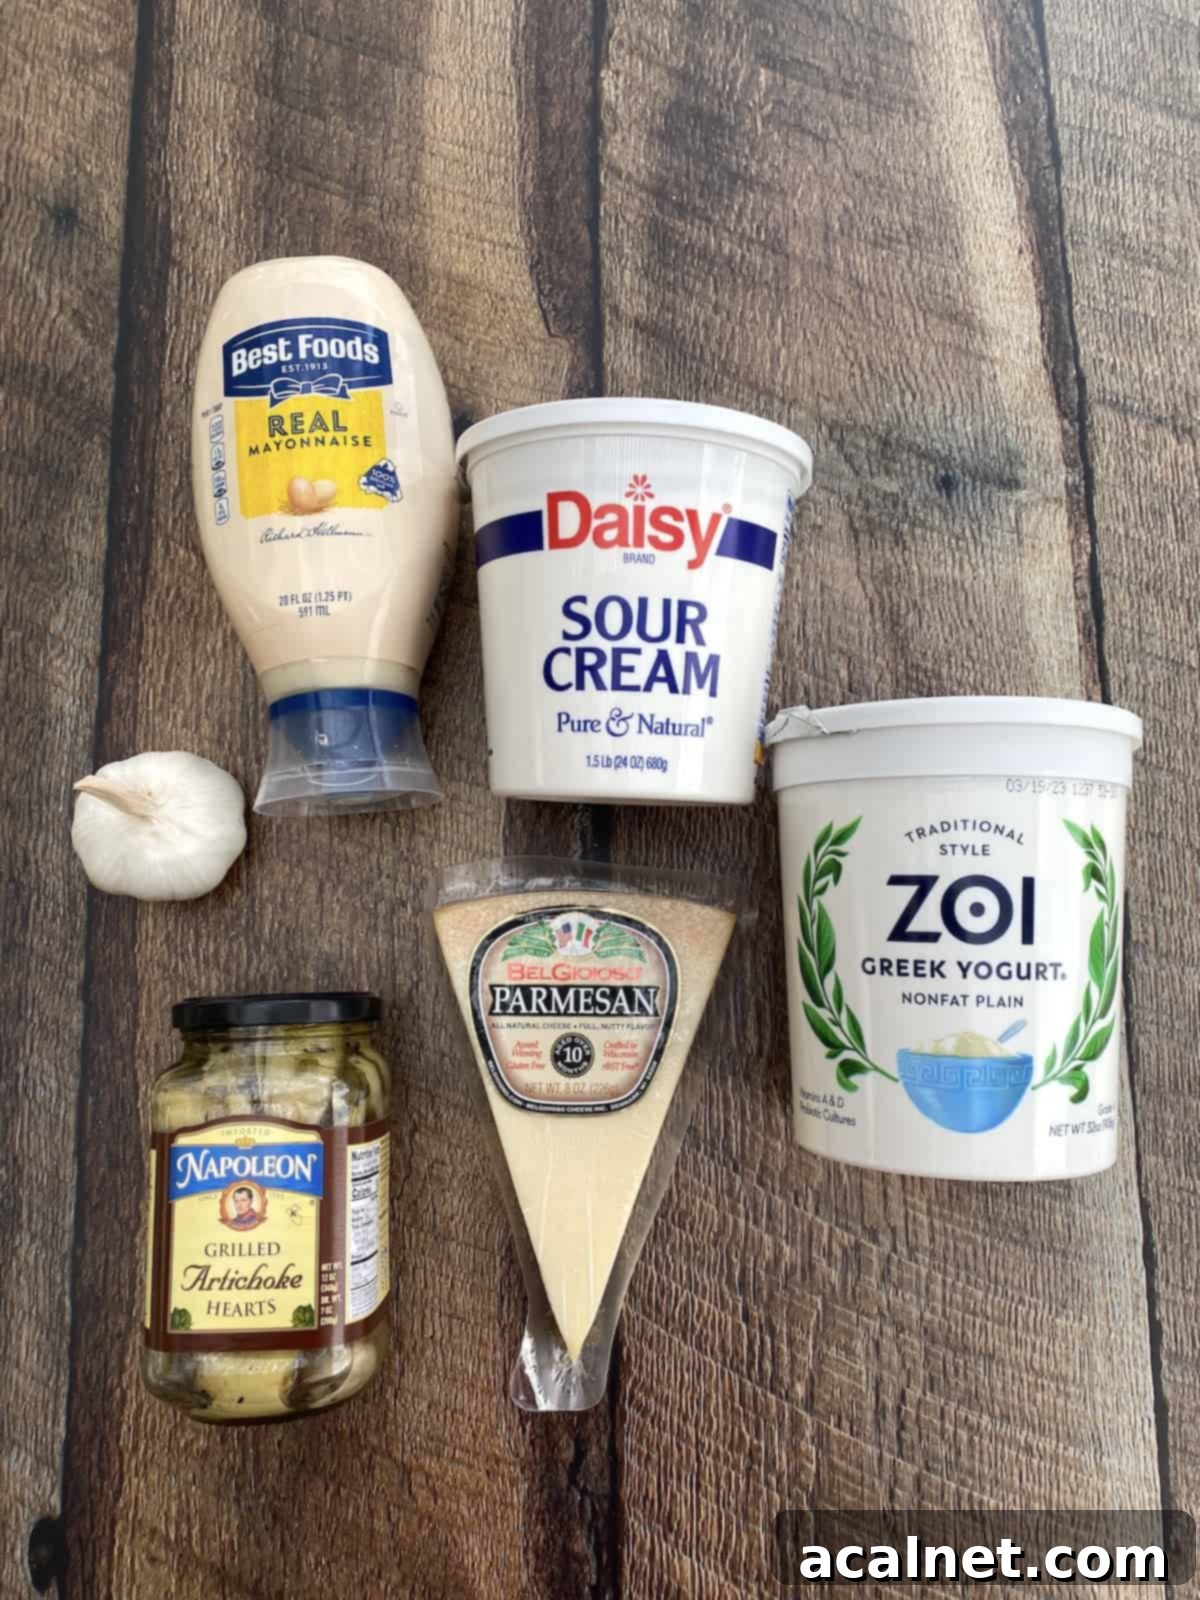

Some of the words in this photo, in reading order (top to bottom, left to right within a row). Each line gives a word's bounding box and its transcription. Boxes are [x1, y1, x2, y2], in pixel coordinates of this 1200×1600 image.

[231, 336, 293, 378] Best
[298, 333, 380, 364] Foods
[281, 362, 328, 373] EST.1913
[268, 410, 347, 438] REAL
[248, 435, 372, 457] MAYONNAISE
[546, 489, 723, 570] Daisy
[623, 552, 655, 564] BRAND
[278, 595, 289, 606] 20
[290, 594, 300, 604] FL
[302, 592, 312, 603] OZ
[314, 591, 335, 604] (1.25
[337, 590, 352, 603] PT)
[298, 606, 313, 618] 591
[562, 595, 707, 646] SOUR
[542, 646, 721, 698] CREAM
[556, 711, 602, 733] Pure
[605, 707, 634, 737] &
[636, 713, 705, 738] Natural
[586, 755, 600, 768] 1.5
[601, 755, 612, 768] Lb
[614, 755, 628, 770] (24
[630, 756, 644, 771] OZ)
[646, 757, 668, 773] 680g
[904, 818, 1025, 846] TRADITIONAL
[939, 843, 991, 857] STYLE
[886, 874, 1035, 945] ZOI
[860, 957, 947, 980] GREEK
[492, 986, 656, 1015] PARMESAN
[902, 992, 969, 1008] NONFAT
[975, 994, 1024, 1008] PLAIN
[491, 1022, 505, 1030] ALL
[506, 1022, 541, 1030] NATURAL
[555, 1037, 572, 1056] AGED
[574, 1037, 591, 1056] OVER
[563, 1046, 583, 1063] 10
[557, 1060, 589, 1075] MONTHS
[525, 1082, 543, 1094] NET
[564, 1082, 571, 1094] 8
[822, 1093, 828, 1105] A
[837, 1095, 845, 1109] D
[221, 1128, 271, 1137] IMPORTED
[1048, 1123, 1069, 1137] NET
[1071, 1121, 1086, 1135] WT
[176, 1149, 318, 1189] NAPOLEON
[204, 1241, 281, 1258] GRILLED
[180, 1263, 303, 1292] Artichoke
[206, 1299, 277, 1317] HEARTS
